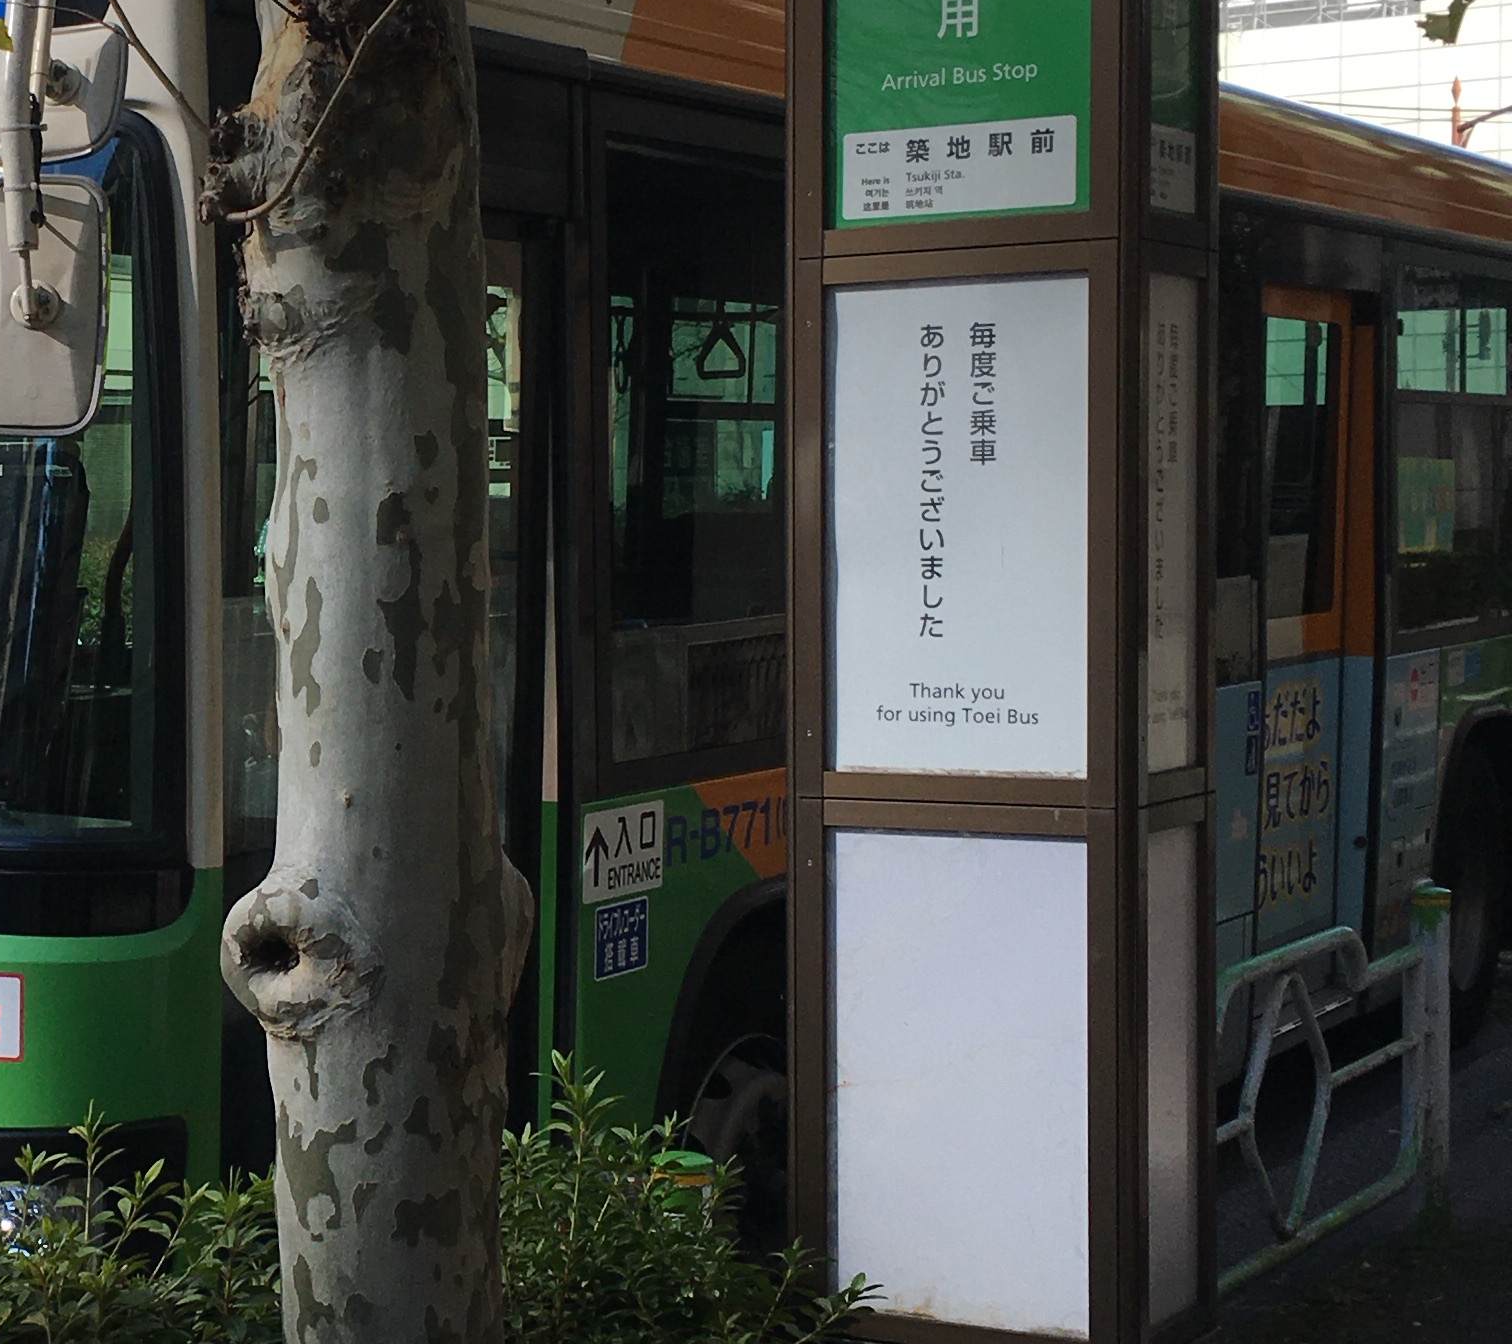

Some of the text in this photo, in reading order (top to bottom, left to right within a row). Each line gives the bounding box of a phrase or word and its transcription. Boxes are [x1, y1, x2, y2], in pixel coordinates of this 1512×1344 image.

[881, 60, 1038, 91] Arrival Bus Stop
[854, 127, 1056, 164] ここは 築地駅前
[860, 168, 966, 187] Here is Tsukiji Sta.
[968, 320, 997, 467] 毎度ご乗車
[918, 323, 946, 640] ありがとうございました
[909, 681, 1006, 708] Thank you
[876, 705, 1040, 727] for using Toei Bus
[614, 810, 656, 859] 入口
[607, 856, 661, 891] ENTRANCE
